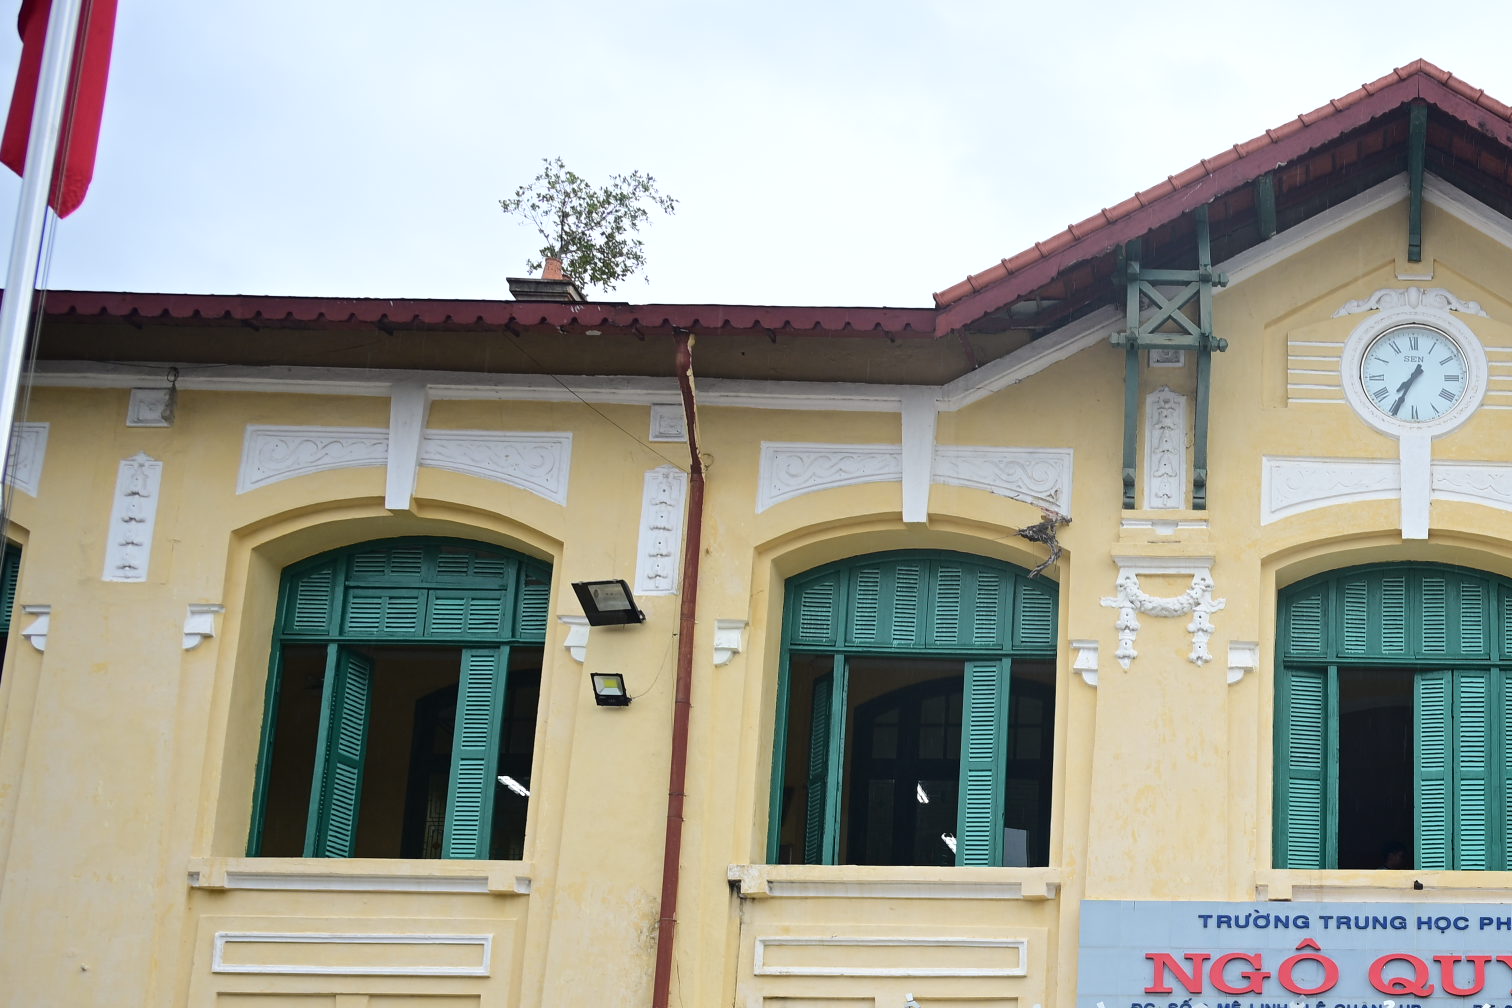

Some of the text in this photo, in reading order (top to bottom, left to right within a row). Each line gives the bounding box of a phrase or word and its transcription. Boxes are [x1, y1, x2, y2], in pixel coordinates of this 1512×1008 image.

[1198, 909, 1310, 929] TRƯỜNG
[1319, 914, 1407, 930] TRUNG
[1416, 916, 1469, 934] HỌC
[1144, 937, 1339, 996] NGÔ
